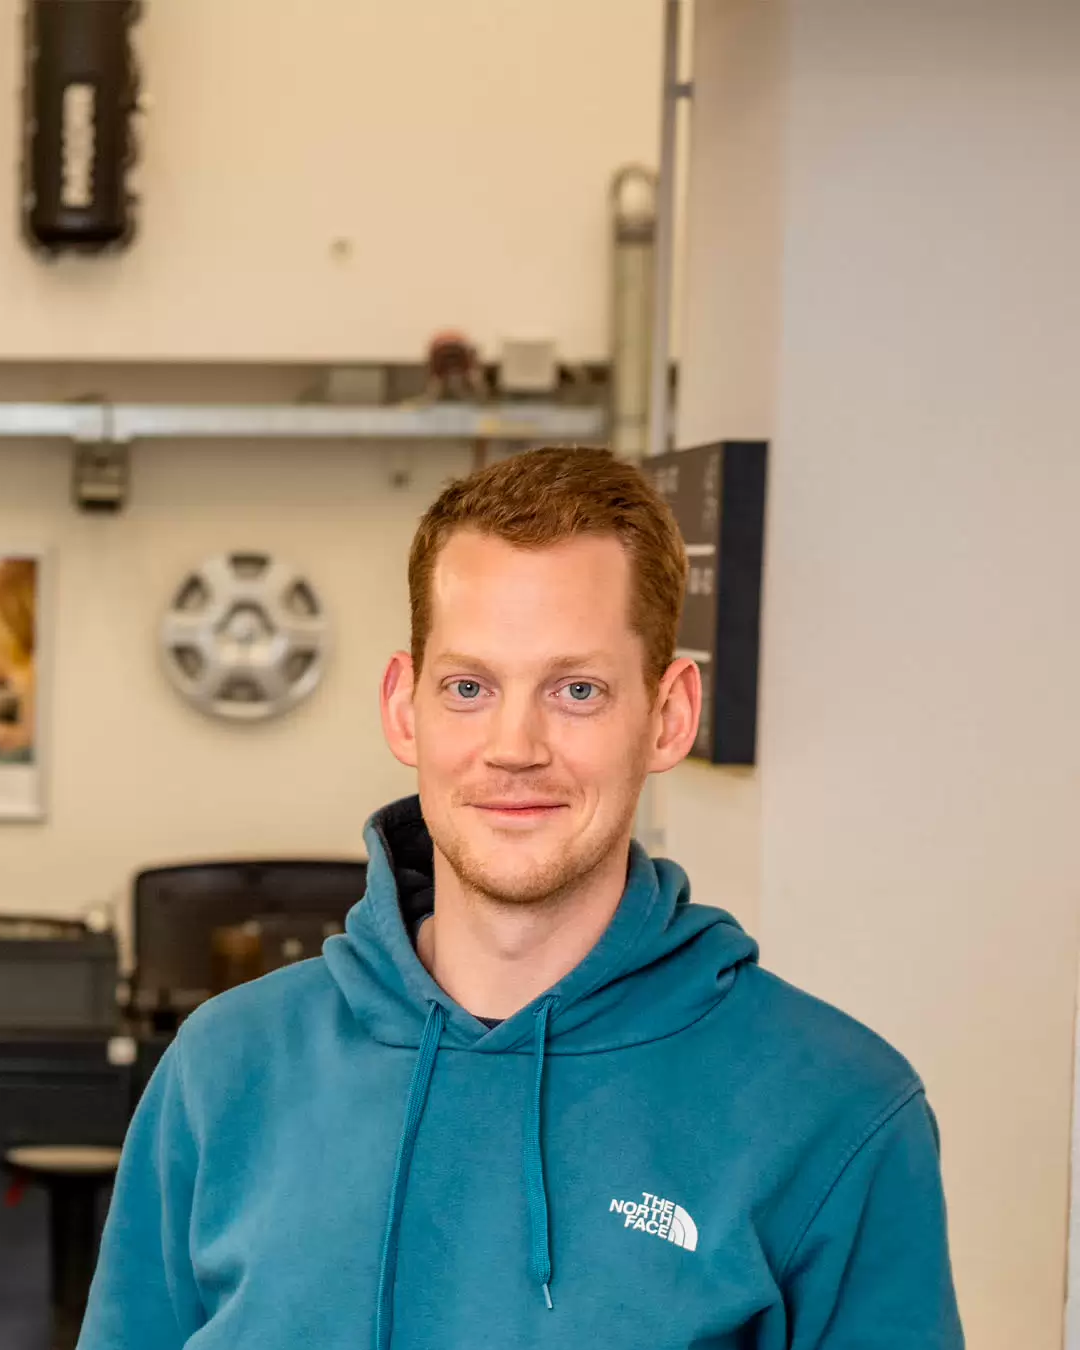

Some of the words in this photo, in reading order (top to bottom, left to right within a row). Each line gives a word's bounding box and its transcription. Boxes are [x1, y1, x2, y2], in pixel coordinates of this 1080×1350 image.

[609, 1199, 673, 1228] NORTH
[642, 1191, 675, 1214] THE
[624, 1214, 670, 1239] FACE
